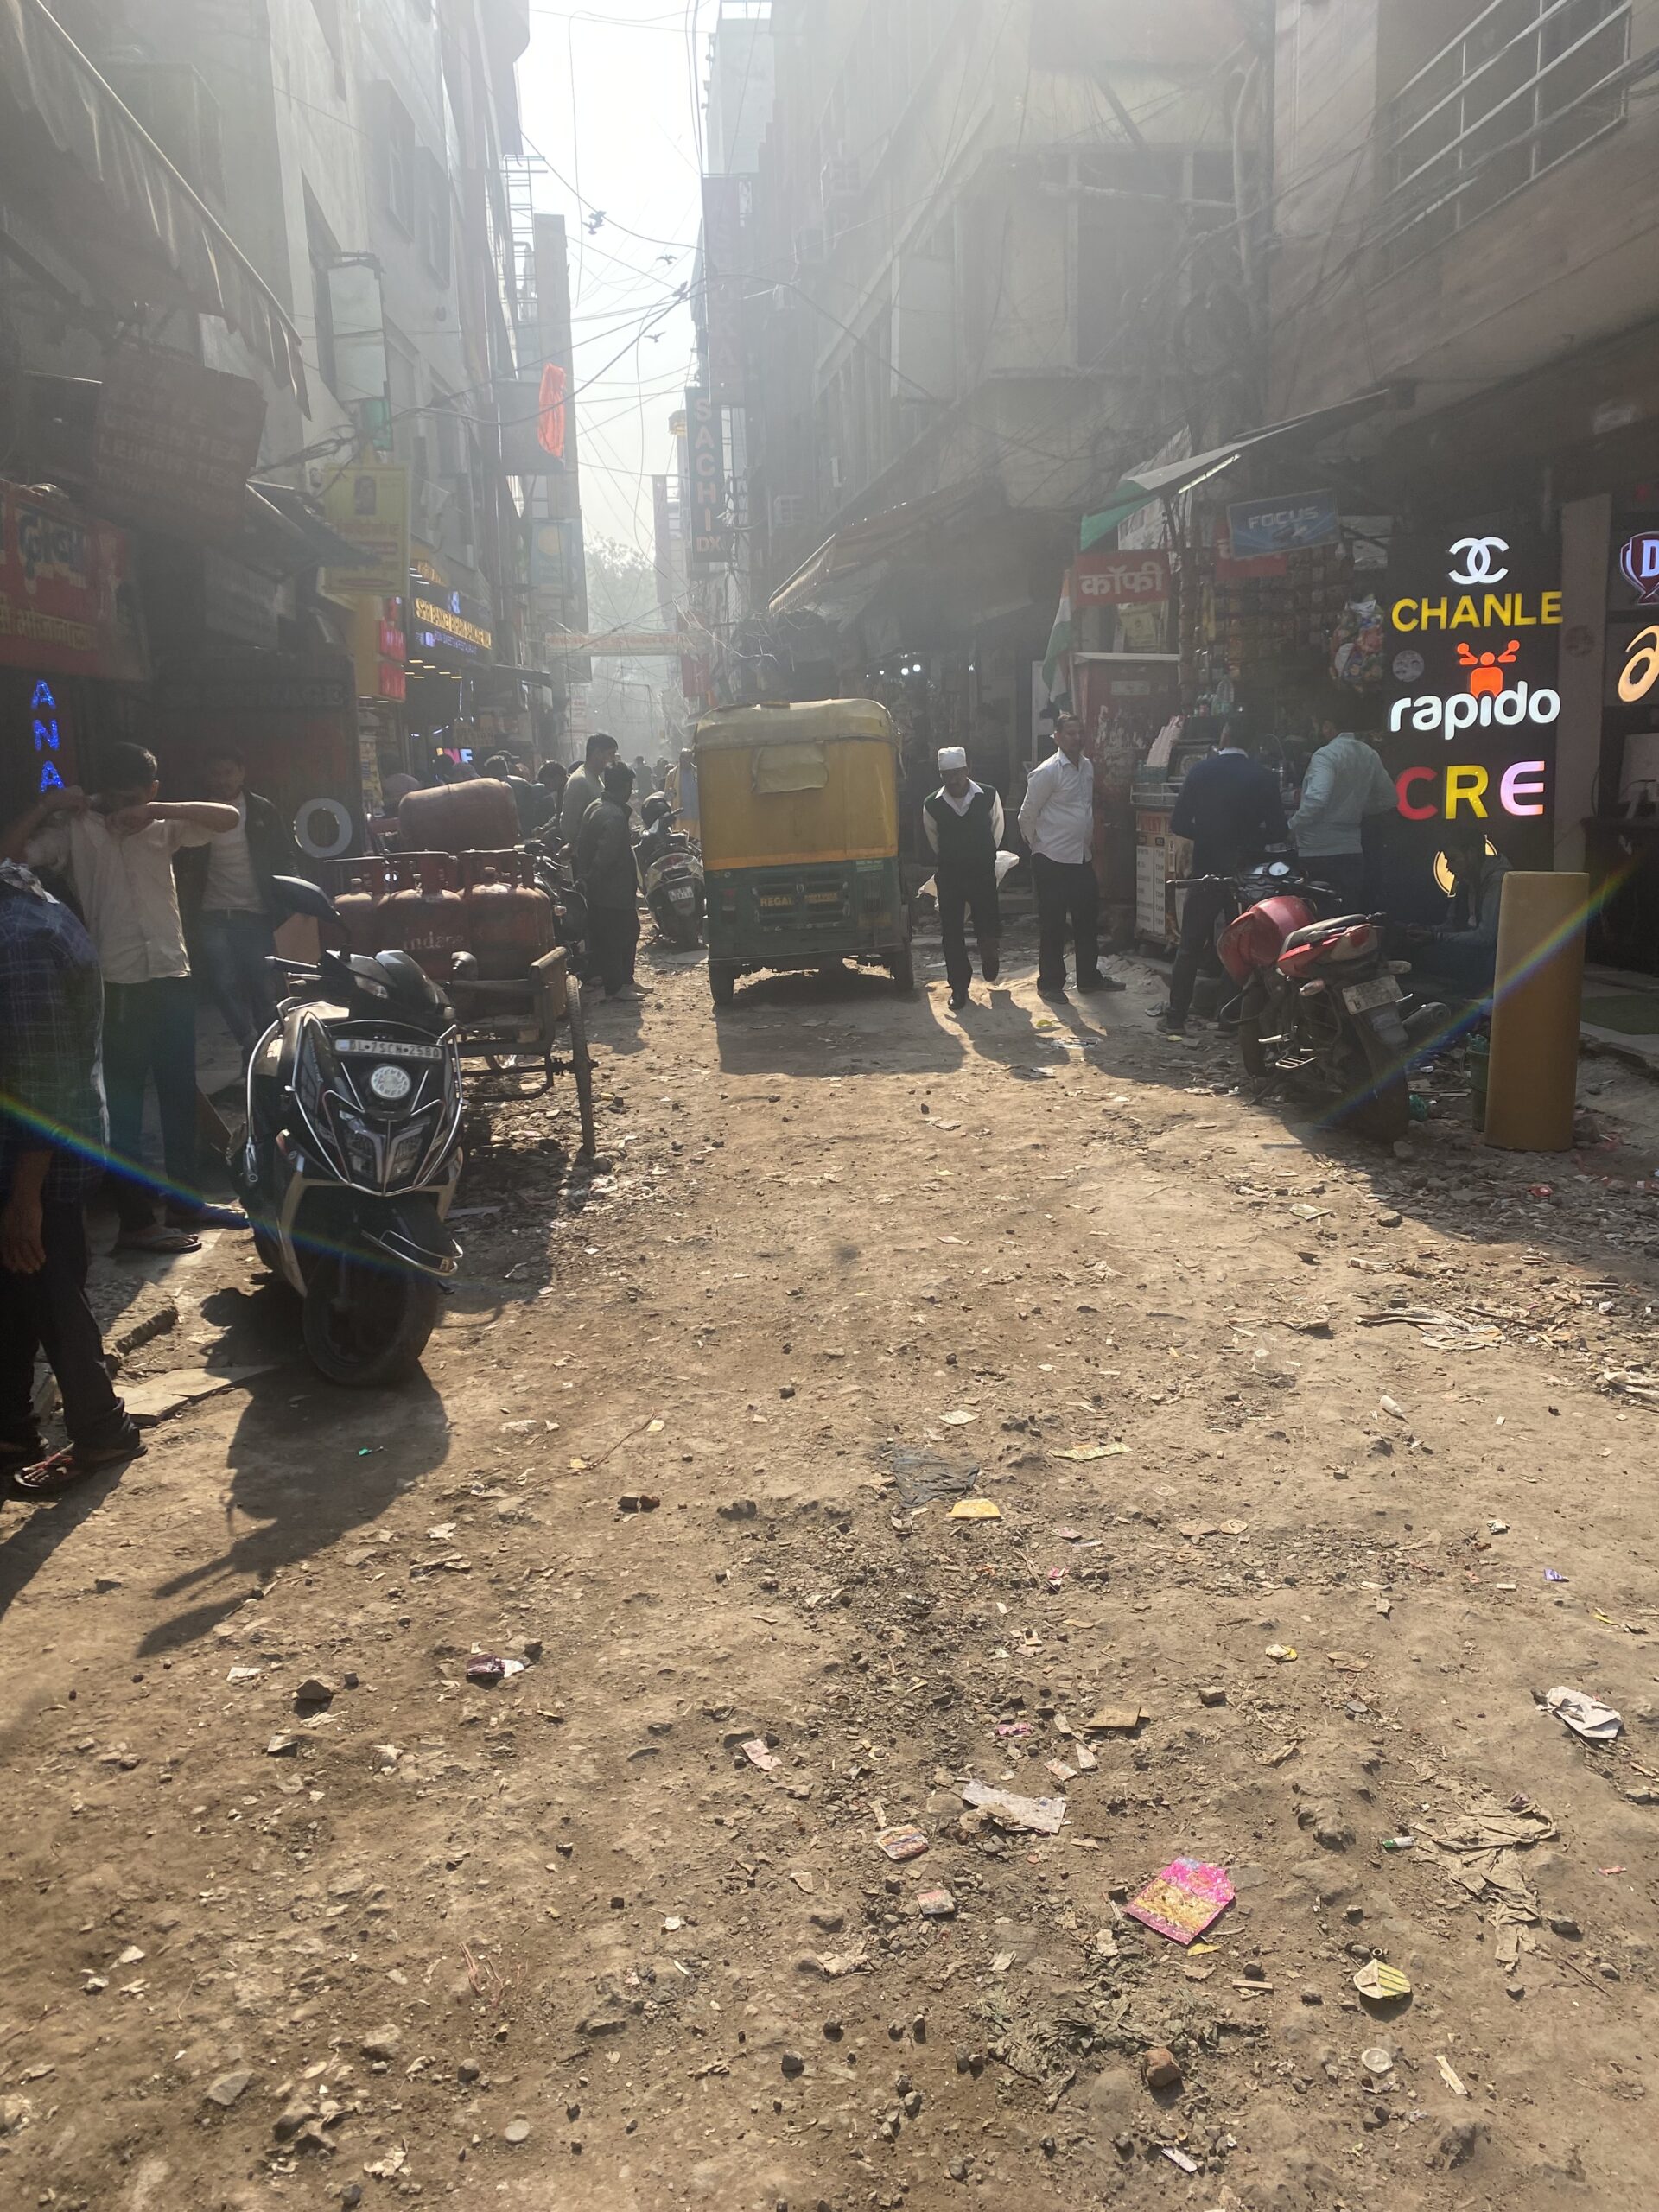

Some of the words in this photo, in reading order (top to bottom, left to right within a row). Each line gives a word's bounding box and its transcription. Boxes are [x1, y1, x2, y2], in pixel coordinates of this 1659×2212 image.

[693, 397, 717, 532] SACHI
[1247, 505, 1319, 531] FOCUS
[1078, 560, 1165, 597] कॉफी
[1391, 591, 1562, 632] CHANLE
[1390, 681, 1560, 741] rapido
